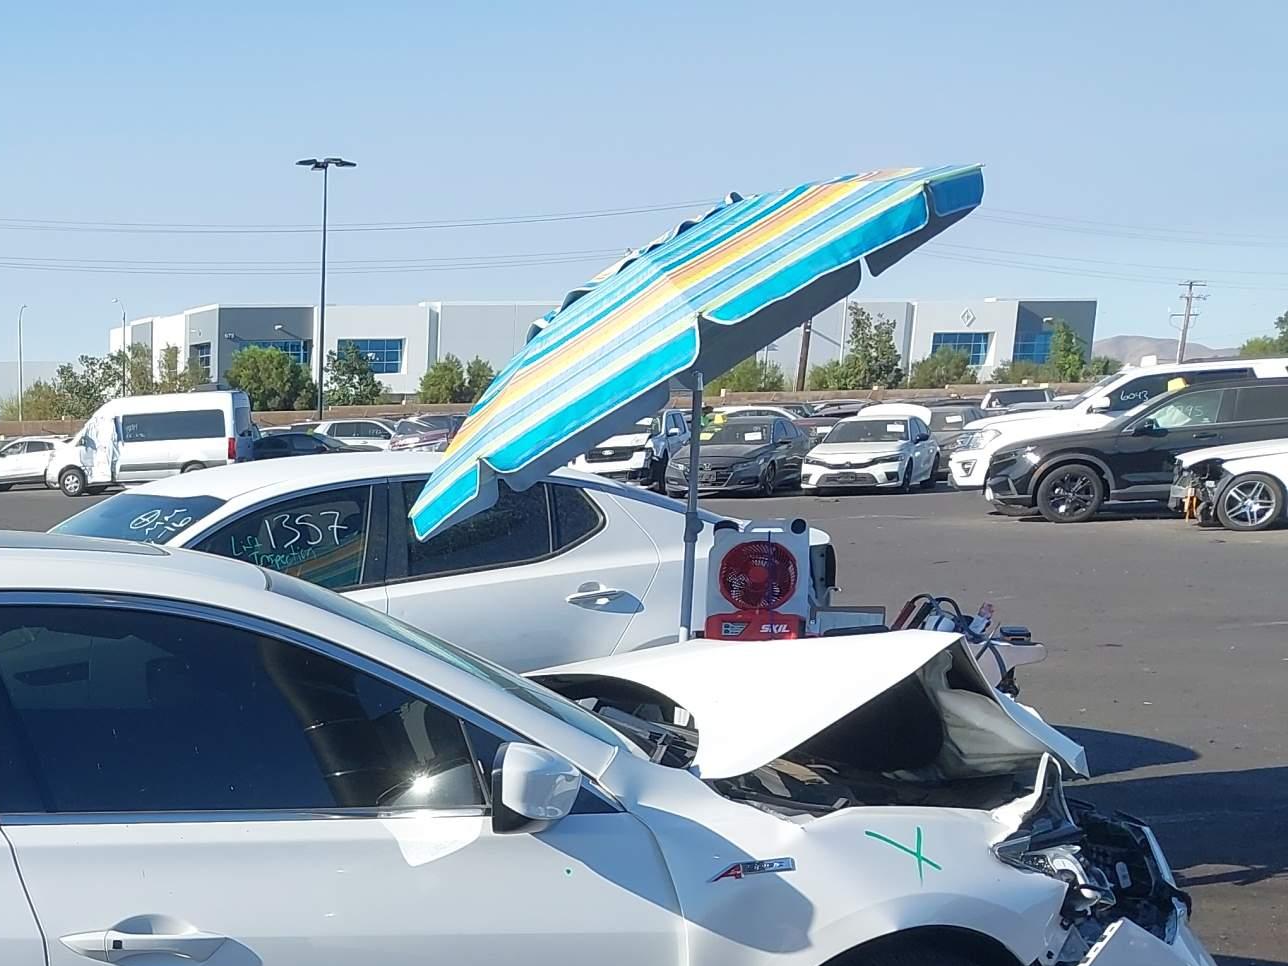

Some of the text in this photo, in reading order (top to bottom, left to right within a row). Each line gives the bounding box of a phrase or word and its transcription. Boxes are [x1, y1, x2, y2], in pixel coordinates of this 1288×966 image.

[1120, 391, 1148, 401] 6043
[265, 511, 349, 548] 1357
[231, 535, 262, 556] Lift
[759, 624, 791, 634] SKIL
